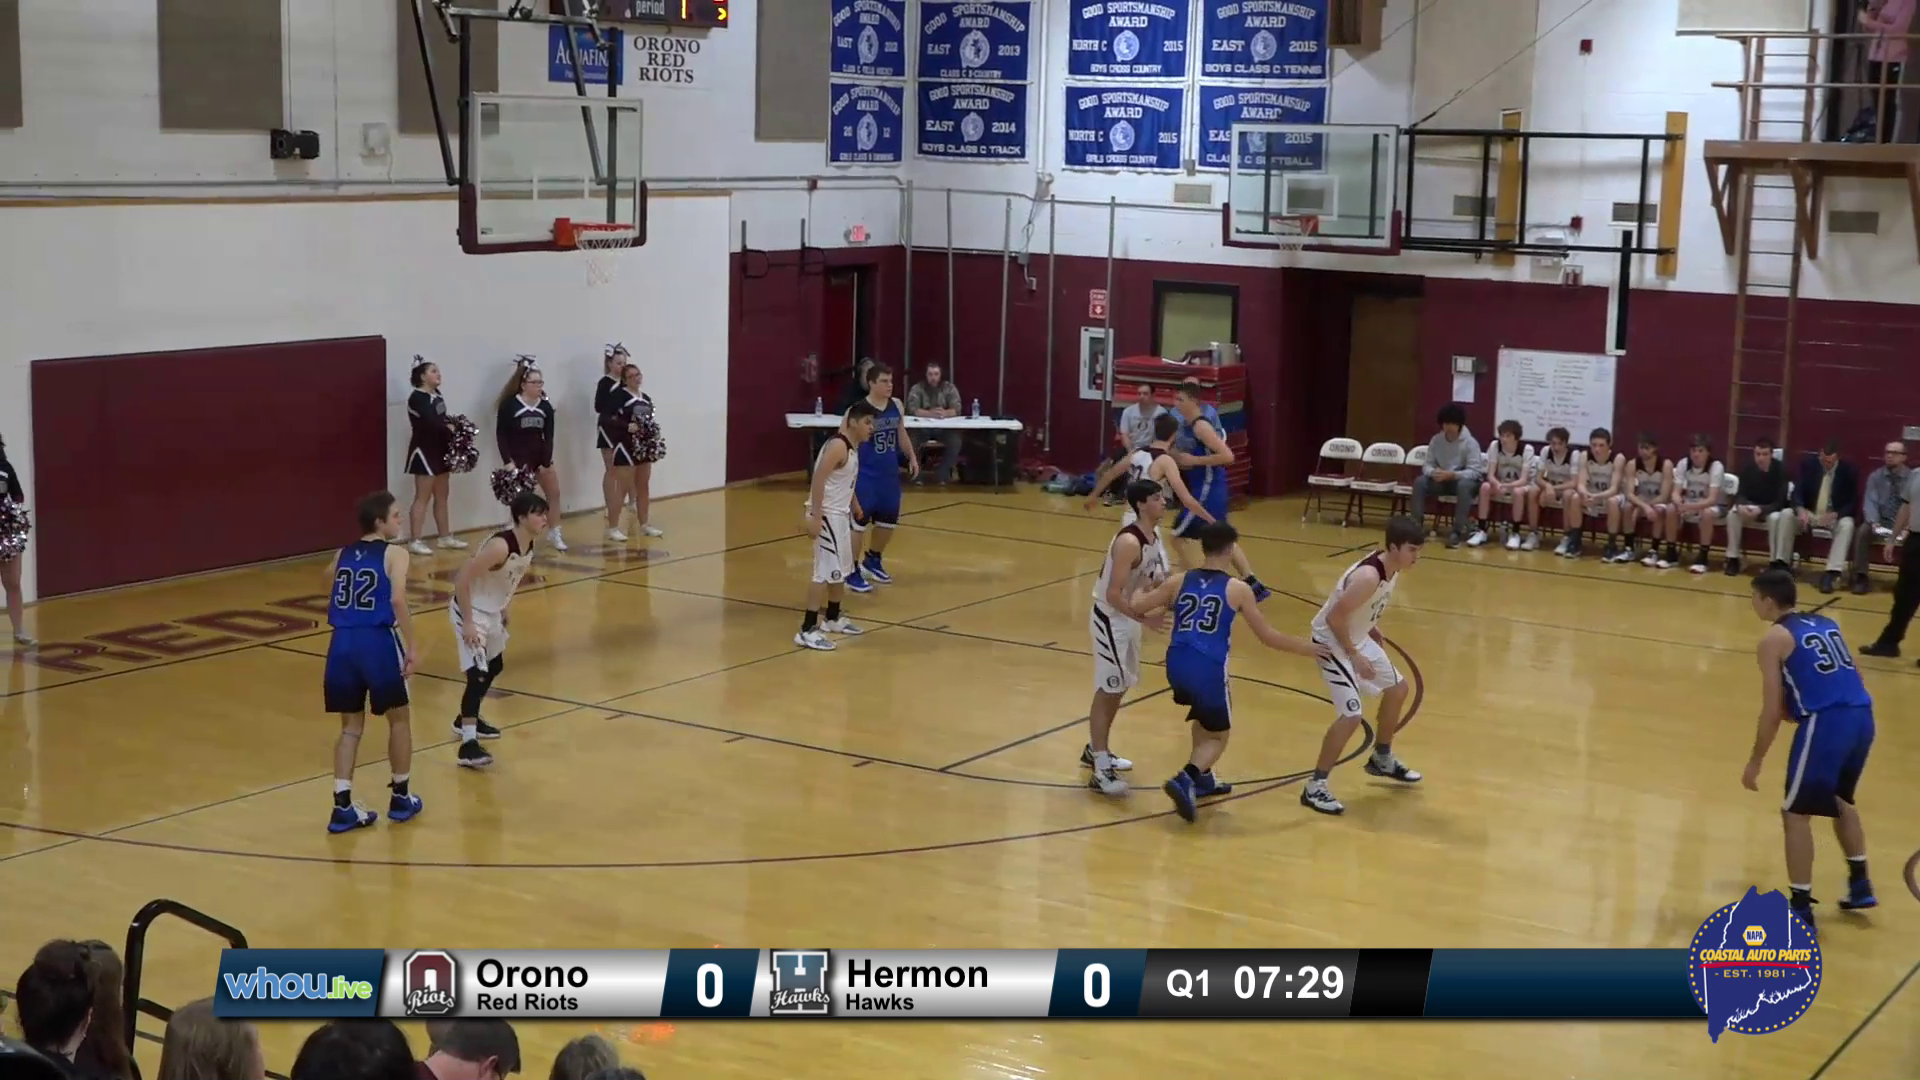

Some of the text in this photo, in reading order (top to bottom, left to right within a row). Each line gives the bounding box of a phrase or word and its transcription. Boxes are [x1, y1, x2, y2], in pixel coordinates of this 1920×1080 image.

[636, 0, 664, 16] period
[1081, 1, 1176, 20] GOOD SPORTSMANSHIP
[1217, 1, 1316, 20] GOOD SPORTSMANSHIP
[834, 0, 901, 32] GOOD SPORTSMANSHIP
[859, 12, 880, 25] AWARD
[924, 3, 1025, 34] GOOD SPORTSMANSHIP
[1108, 16, 1148, 28] AWARD
[1244, 16, 1286, 28] AWARD
[959, 17, 990, 28] AWARD
[634, 36, 700, 54] ORONO
[837, 36, 853, 49] EAST
[1072, 40, 1107, 51] NORTH C
[1163, 40, 1184, 52] 2015
[1211, 40, 1245, 52] EAST
[1288, 40, 1318, 52] 2015
[555, 39, 621, 67] AAFIN
[927, 44, 951, 55] EAST
[998, 45, 1020, 56] 2013
[648, 52, 685, 68] RED
[940, 69, 960, 78] CLASS
[1090, 64, 1162, 74] BOYS CROSS COUNTRY
[1205, 64, 1322, 74] BOYS CLASS C TENNIS
[639, 67, 694, 84] RIOTS
[929, 84, 1015, 102] GOOD SPORTSMANSHIP
[832, 86, 901, 116] GOOD SPORTSMANSHIP
[857, 100, 879, 111] AWARD
[953, 98, 990, 110] AWARD
[1078, 92, 1170, 112] GOOD SPORTSMANSHIP
[1213, 91, 1311, 112] GOOD SPORTSMANSHIP
[1104, 107, 1143, 118] AWARD
[1240, 107, 1282, 119] AWARD
[925, 120, 954, 132] EAST
[992, 122, 1016, 133] 2014
[1068, 130, 1104, 142] NORTH C
[1158, 132, 1178, 144] 2015
[1208, 130, 1231, 142] EAS
[1284, 132, 1313, 144] 2015
[922, 143, 1021, 154] BOYS CLASS C TRACK
[1086, 154, 1157, 165] GIRLS CROSS COUNTRY
[1206, 154, 1242, 164] CLA
[1244, 155, 1252, 164] C
[1329, 443, 1356, 453] ORONO
[1371, 448, 1398, 458] ORONO
[335, 567, 378, 610] 32
[1178, 592, 1223, 634] 23
[1801, 629, 1855, 674] 30
